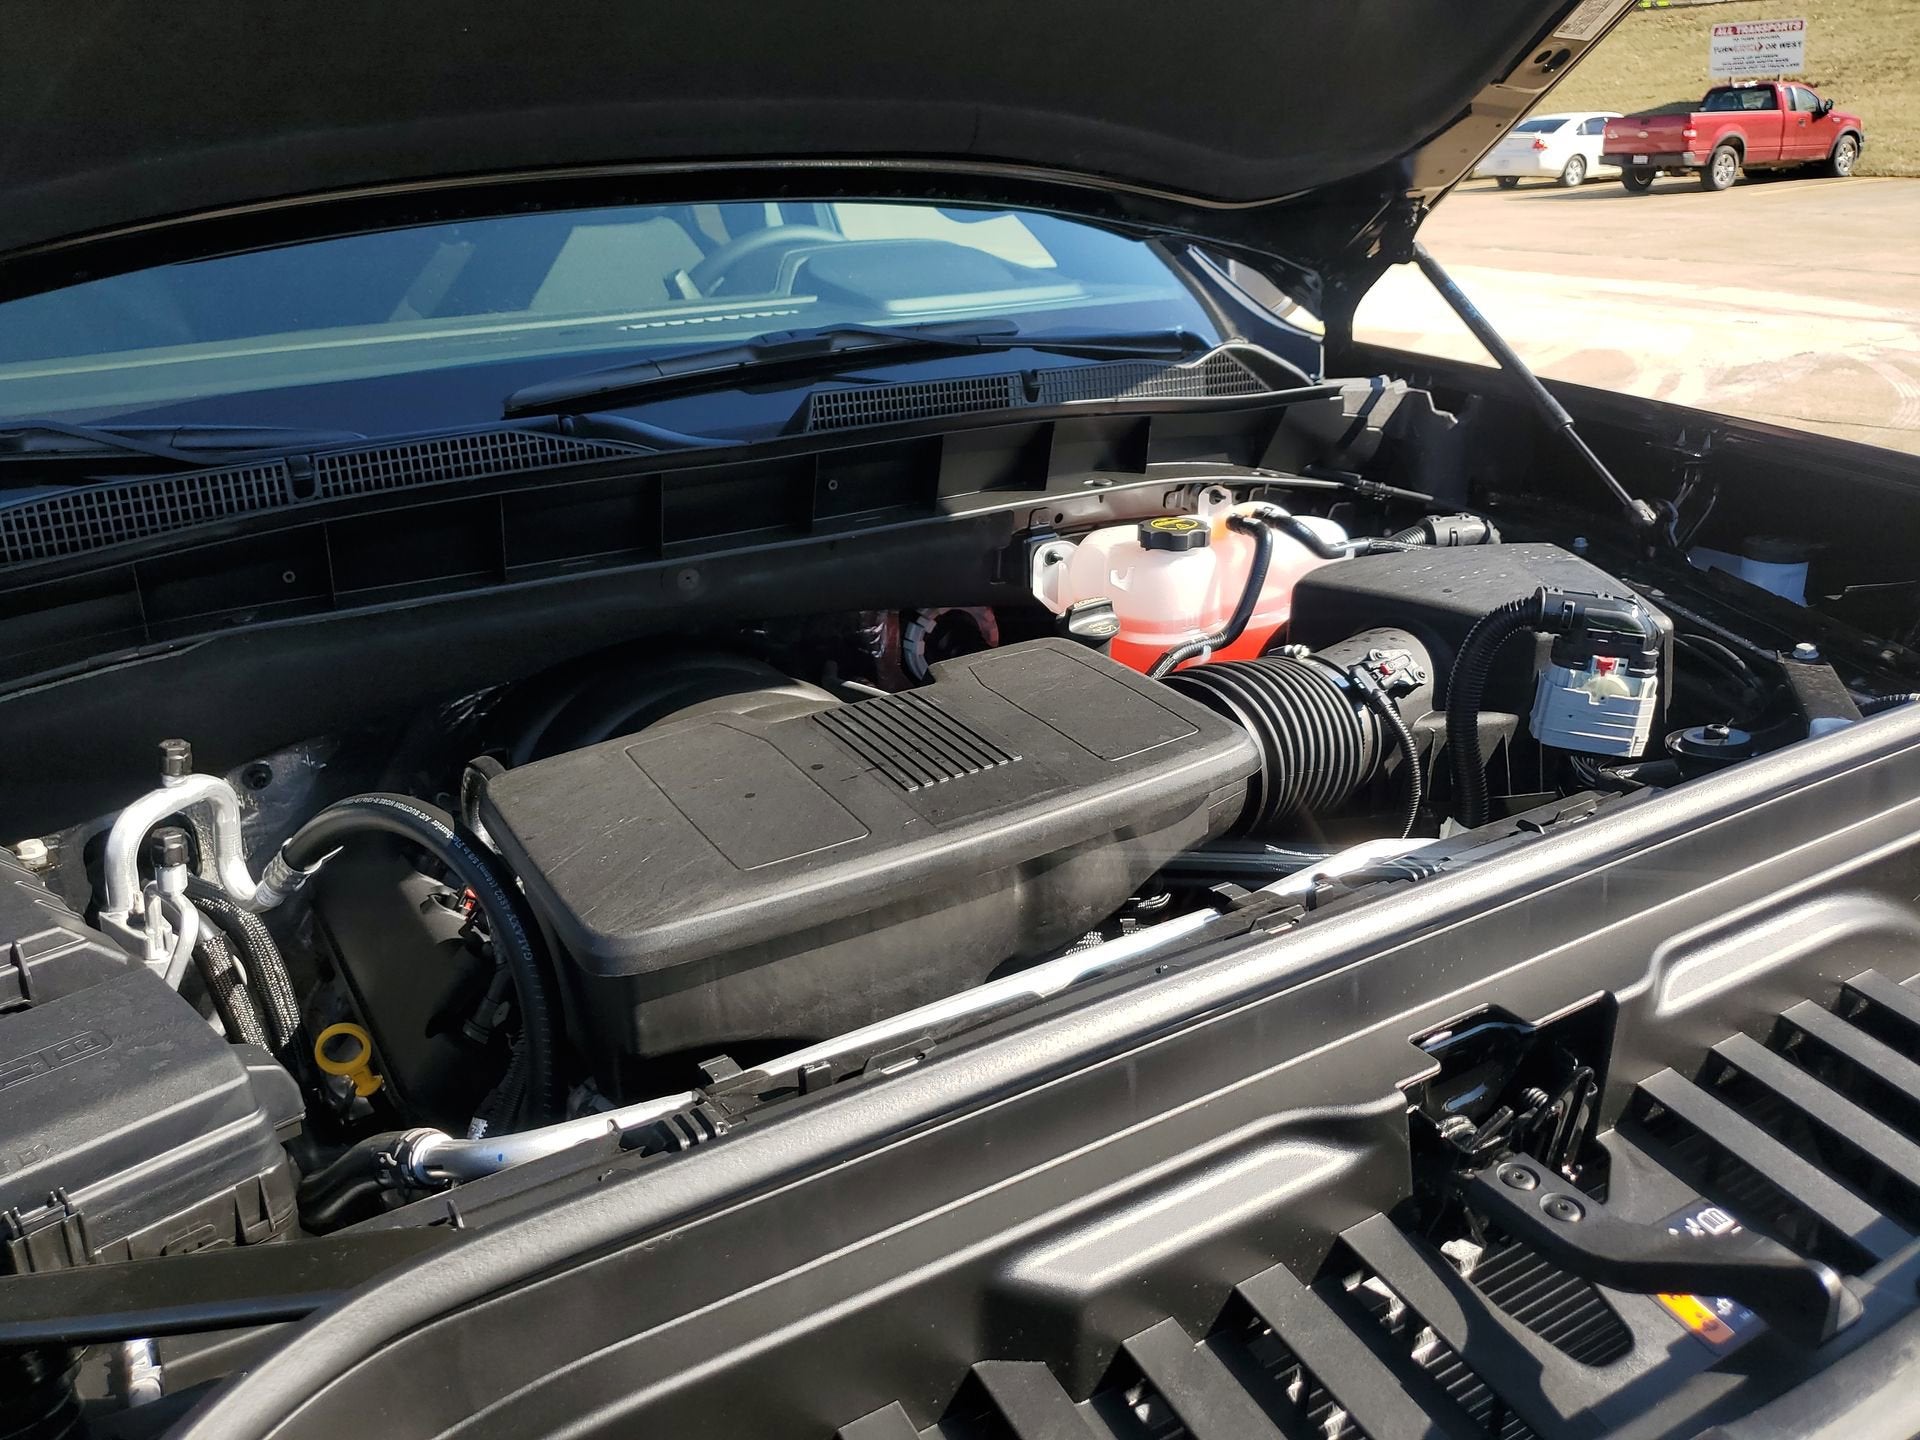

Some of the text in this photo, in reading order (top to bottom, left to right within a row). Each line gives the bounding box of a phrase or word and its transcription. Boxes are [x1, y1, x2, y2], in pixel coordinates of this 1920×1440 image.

[1715, 26, 1735, 36] ALL
[379, 798, 395, 807] HOSE
[393, 801, 421, 816] SUCTION
[419, 812, 432, 822] A/C
[507, 913, 534, 961] GALAXY
